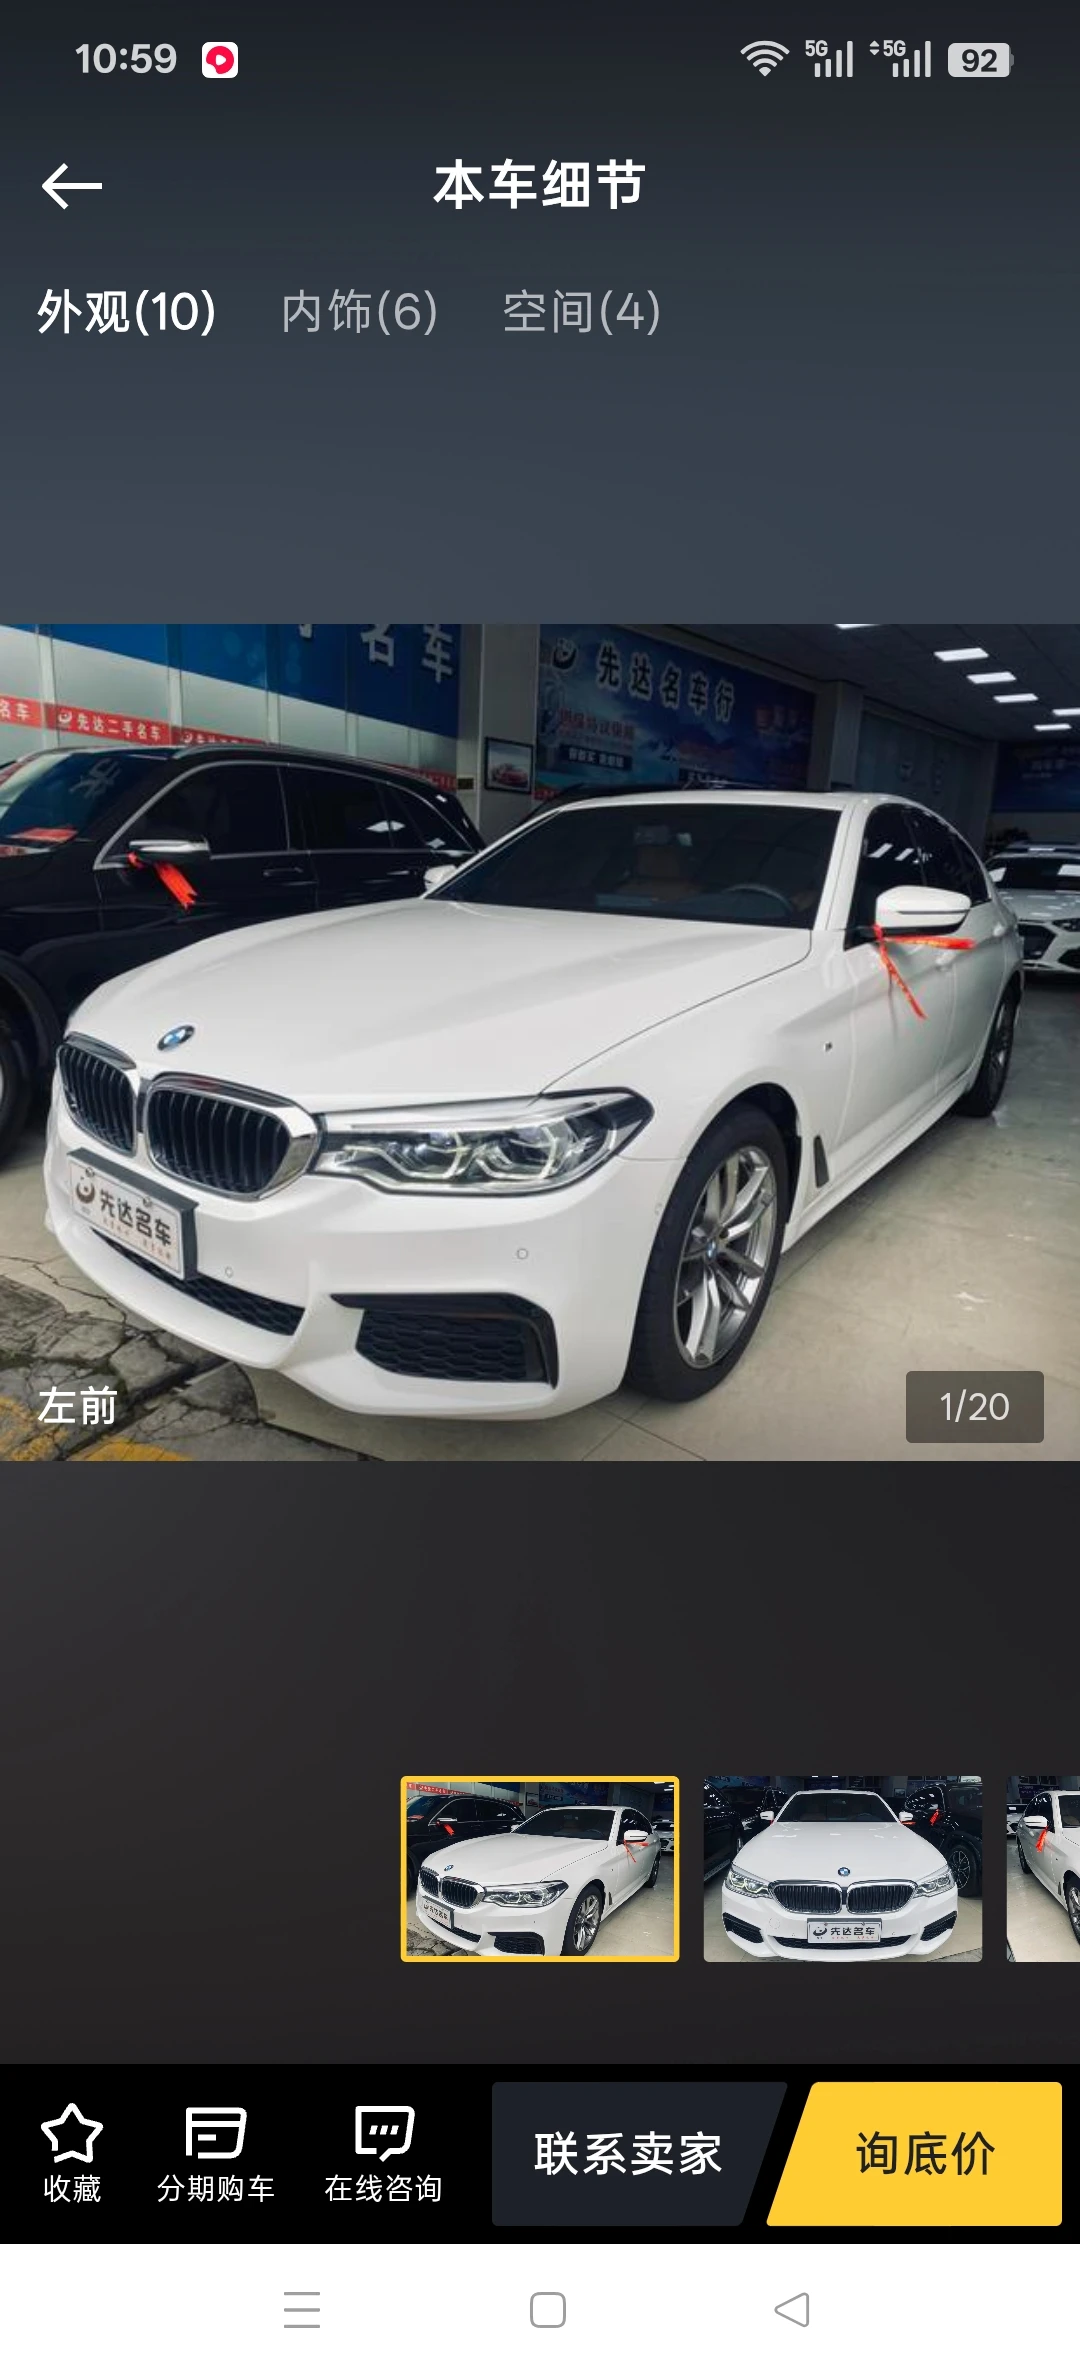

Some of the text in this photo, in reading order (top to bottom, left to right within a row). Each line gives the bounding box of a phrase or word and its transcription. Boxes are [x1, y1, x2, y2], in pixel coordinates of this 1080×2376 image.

[75, 42, 178, 74] 10:59
[804, 39, 829, 57] 5G
[882, 39, 907, 57] 5G
[961, 48, 998, 73] 92
[433, 158, 646, 210] 本车细节
[36, 288, 215, 337] 外观(10)
[282, 288, 438, 336] 内饰(6)
[502, 288, 661, 336] 空间(4)
[597, 640, 734, 724] 先达名车行
[100, 1188, 172, 1246] 先达名车
[533, 2130, 723, 2176] 联系卖家
[855, 2130, 996, 2176] 询底价
[43, 2173, 102, 2204] 收藏
[156, 2173, 275, 2204] 分期购车
[324, 2173, 442, 2204] 在线咨询
